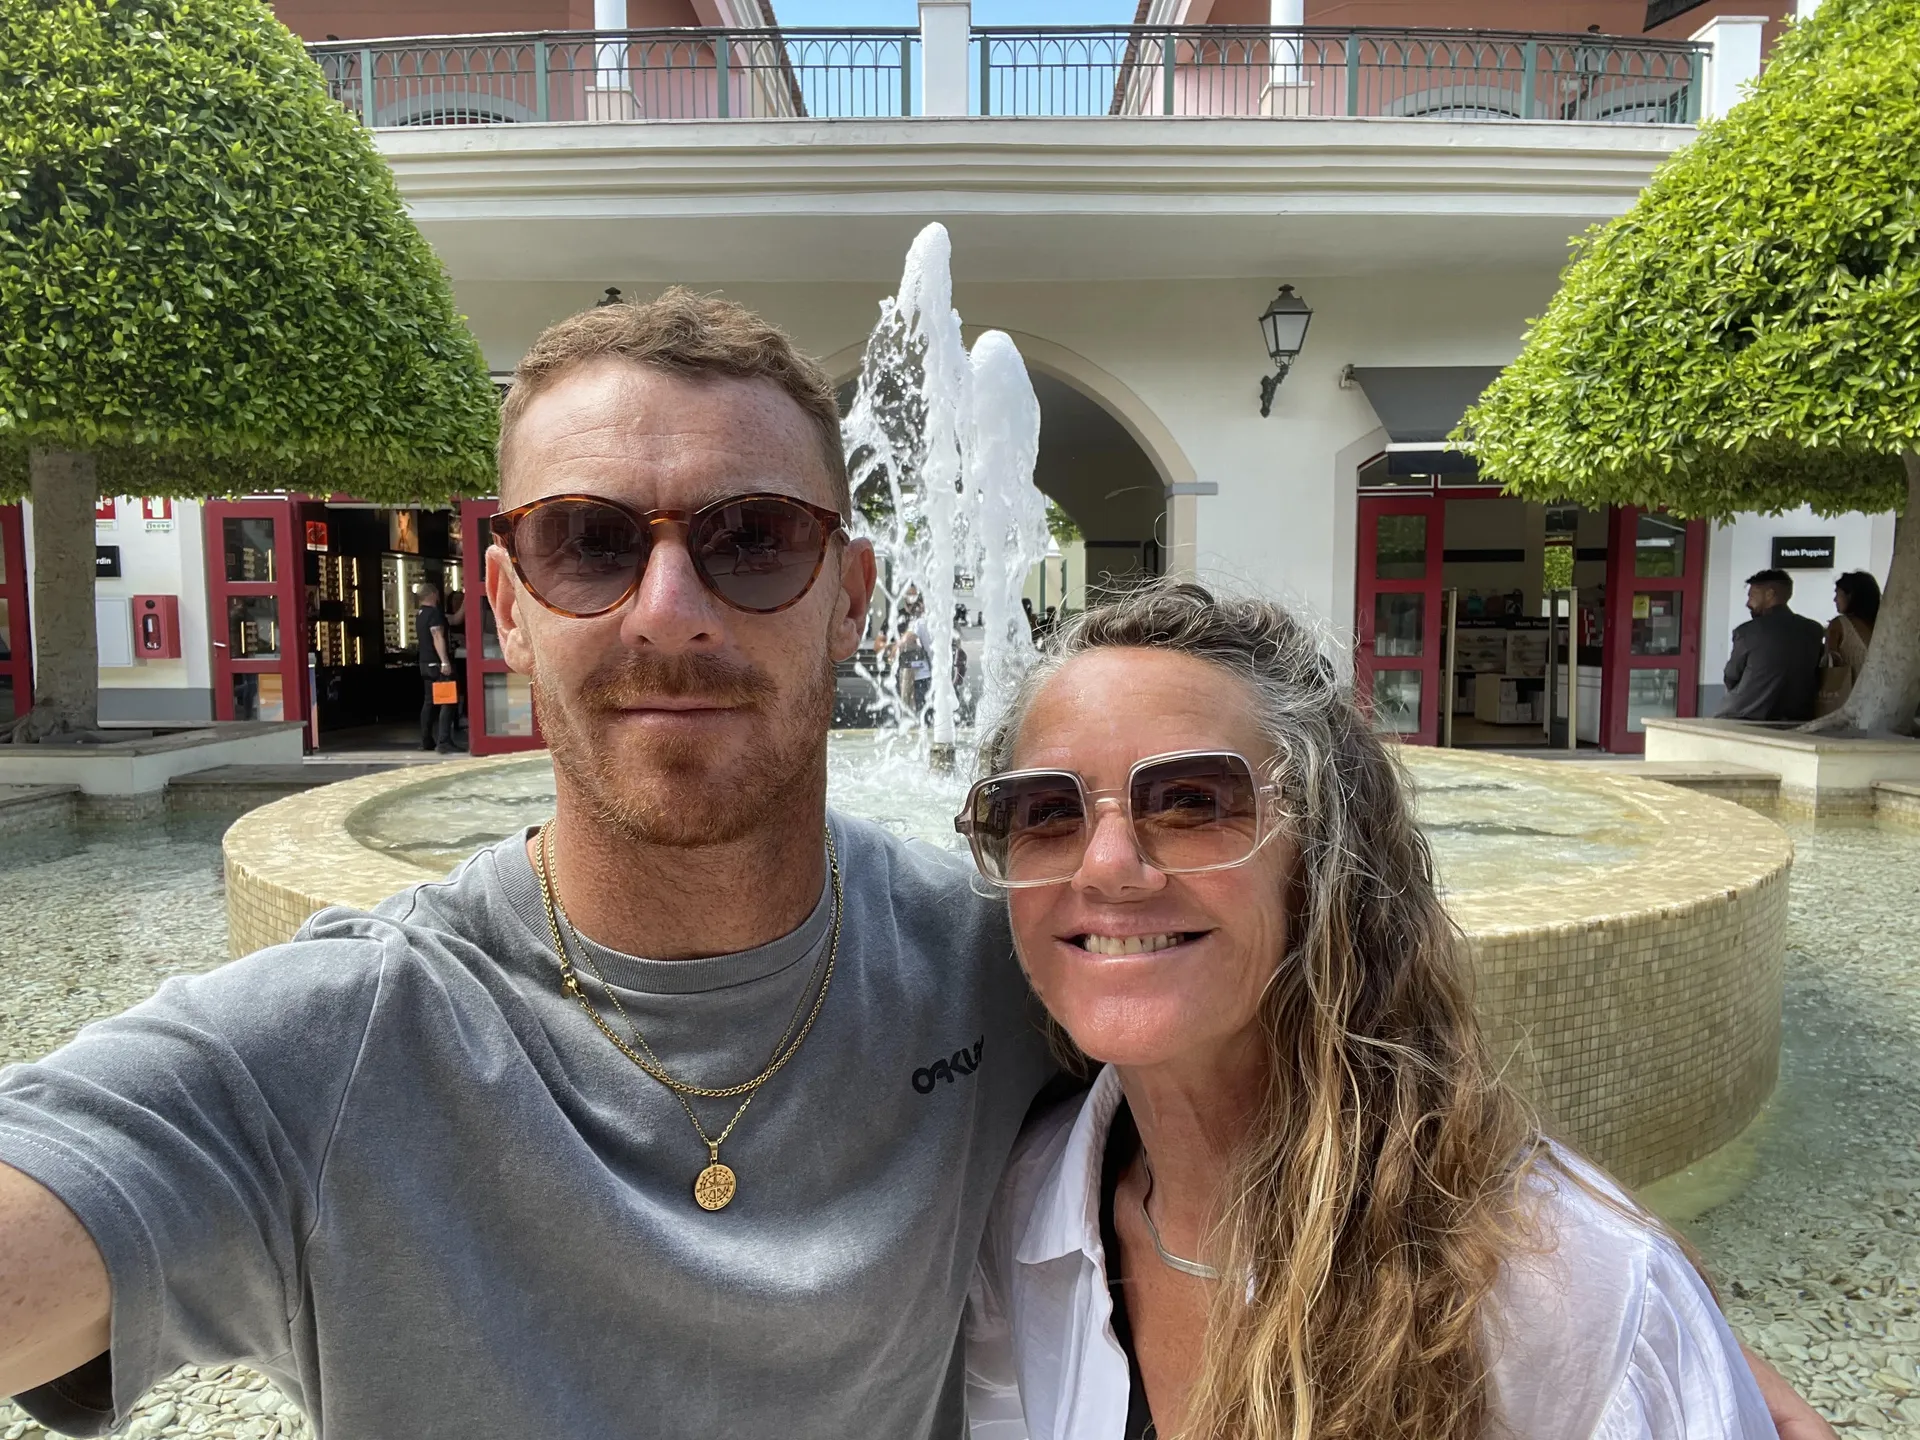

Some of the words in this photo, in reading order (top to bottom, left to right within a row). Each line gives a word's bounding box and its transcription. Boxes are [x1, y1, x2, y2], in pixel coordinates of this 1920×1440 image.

[1781, 549, 1800, 557] Hush
[1801, 548, 1830, 558] Puppies
[96, 556, 112, 565] rdin
